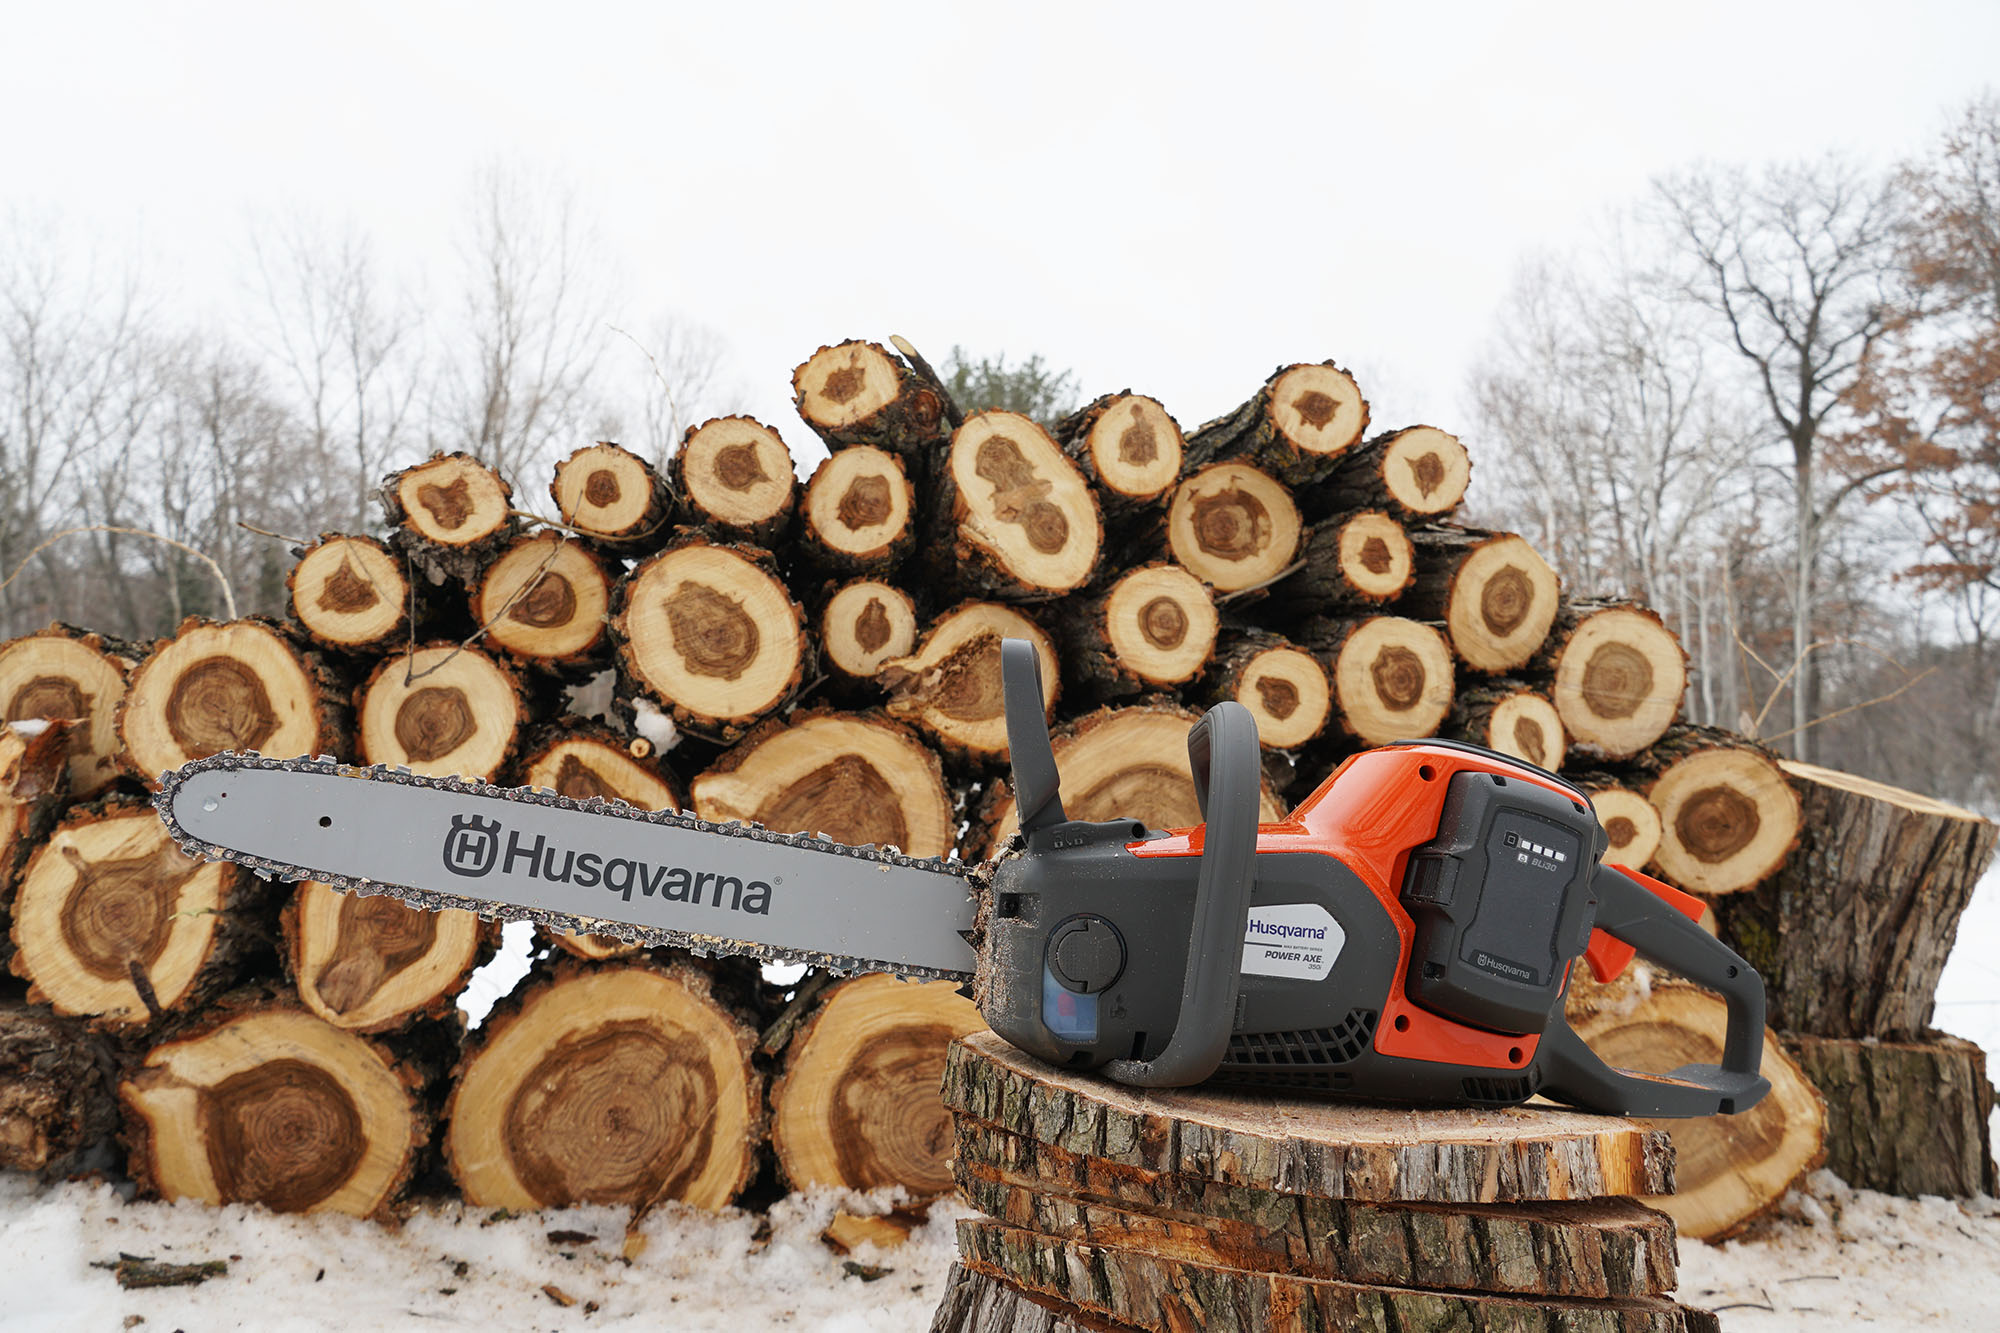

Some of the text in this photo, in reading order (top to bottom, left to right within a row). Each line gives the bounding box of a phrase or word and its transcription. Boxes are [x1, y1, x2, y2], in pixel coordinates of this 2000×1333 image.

[502, 830, 773, 915] Husqvarna
[1249, 919, 1325, 940] Husqvarna
[1264, 950, 1322, 964] POWER AXE
[1486, 957, 1530, 979] Husqvarna
